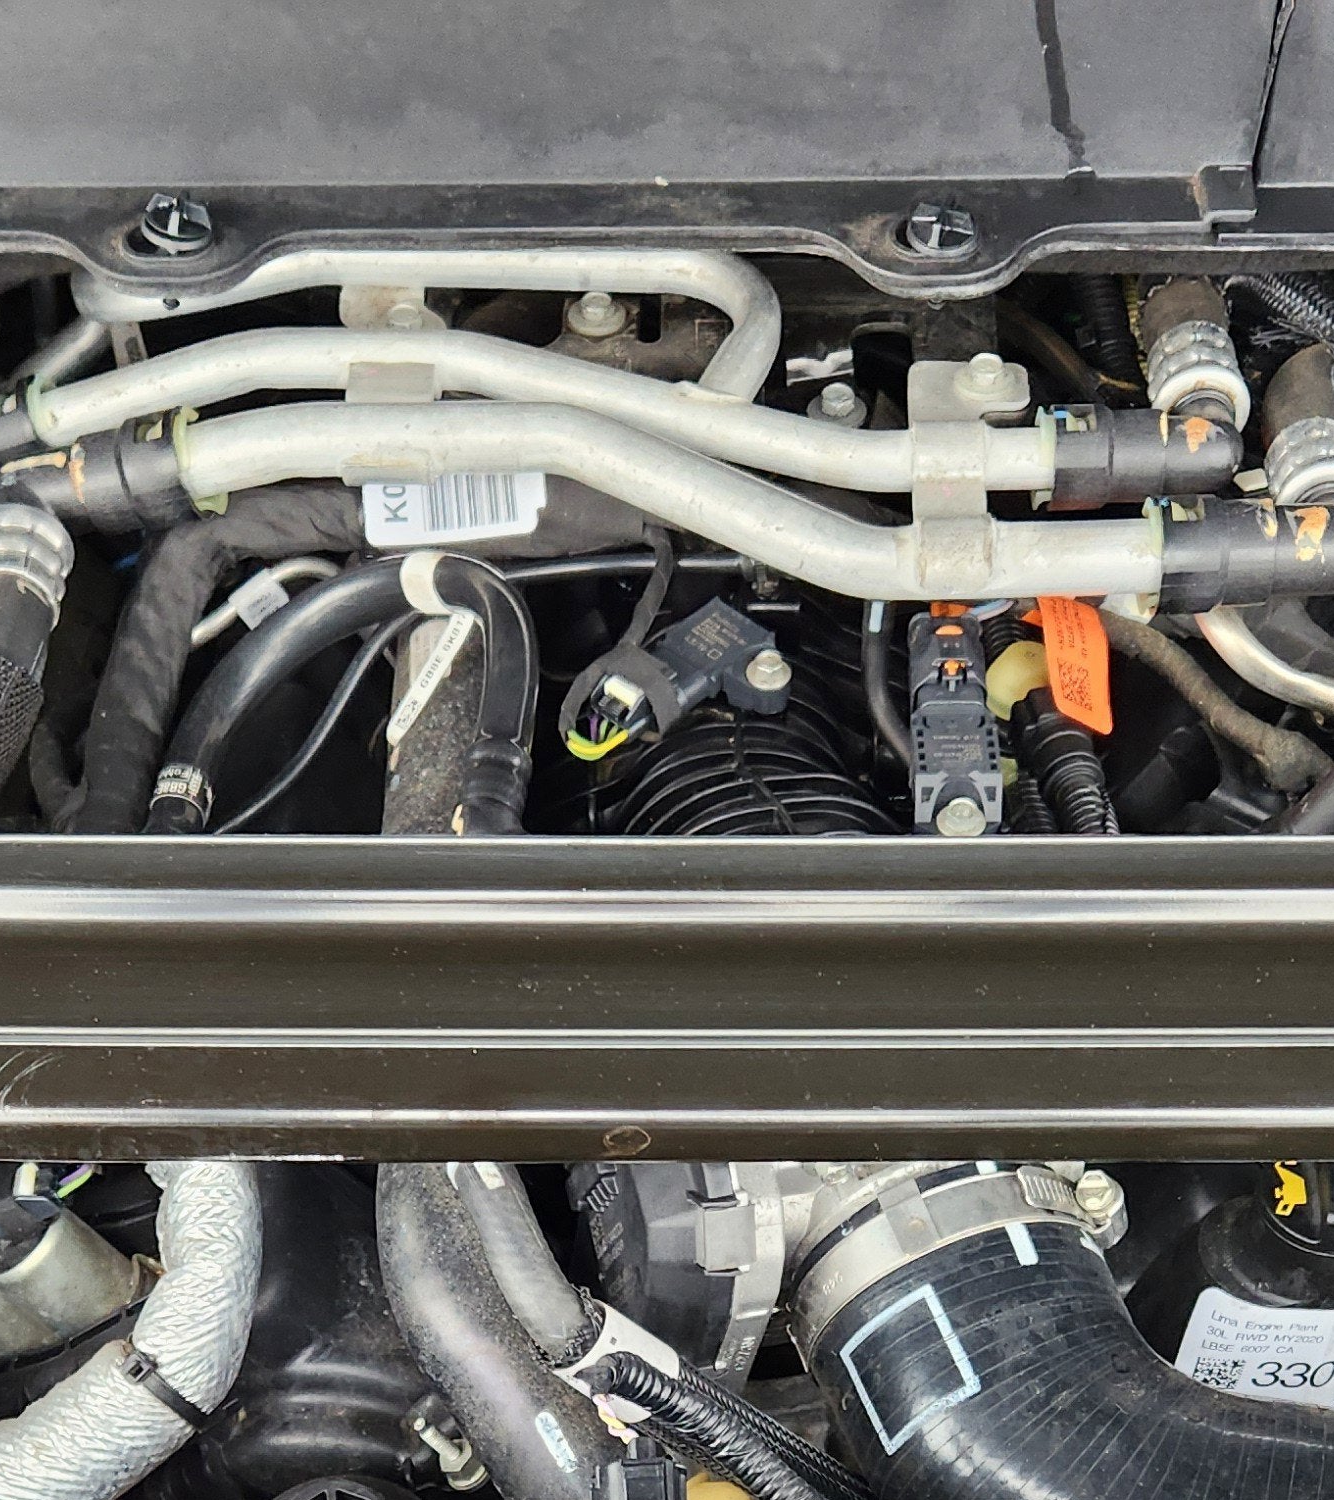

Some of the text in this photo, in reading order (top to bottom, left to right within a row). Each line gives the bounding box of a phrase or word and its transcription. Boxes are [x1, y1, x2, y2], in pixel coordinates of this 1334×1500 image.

[1211, 1309, 1318, 1331] Lima Engine Plant
[1274, 1335, 1324, 1344] MY2020
[1240, 1345, 1270, 1354] 6007
[1276, 1346, 1294, 1354] CA
